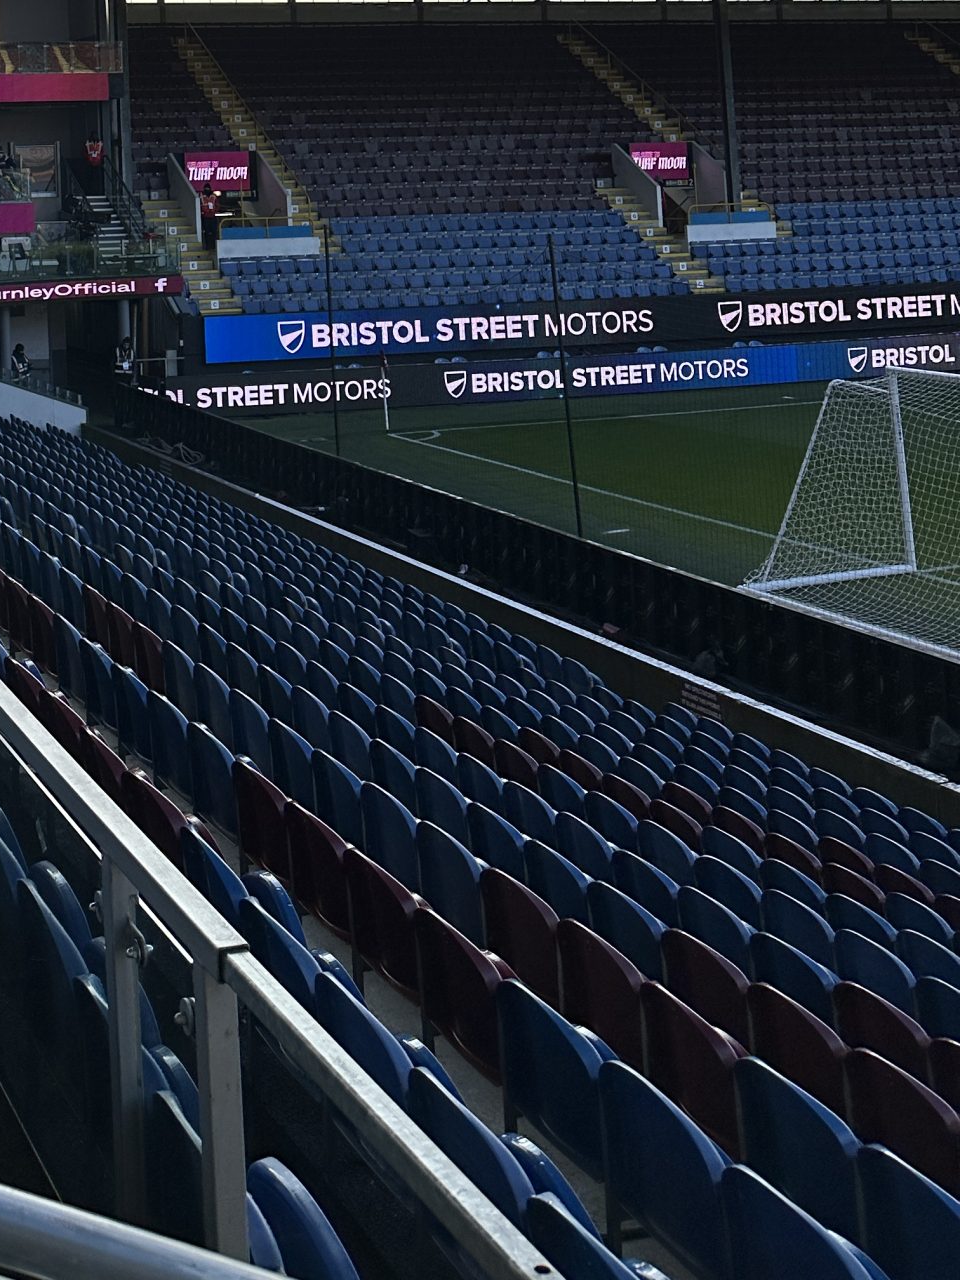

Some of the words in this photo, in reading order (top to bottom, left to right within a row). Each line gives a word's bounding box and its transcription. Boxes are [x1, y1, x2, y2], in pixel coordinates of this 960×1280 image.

[188, 166, 215, 181] TURF
[216, 166, 248, 180] MOOR
[658, 156, 687, 170] MOOR
[748, 300, 851, 327] BRISTOL
[856, 294, 946, 320] STREET
[311, 320, 429, 348] BRISTOL
[436, 314, 539, 342] STREET
[544, 309, 654, 337] MOTORS
[871, 344, 956, 367] BRISTOL
[471, 369, 565, 394] BRISTOL
[572, 363, 656, 388] STREET
[660, 357, 749, 382] MOTORS
[196, 383, 289, 410] STREET
[293, 379, 392, 406] MOTORS
